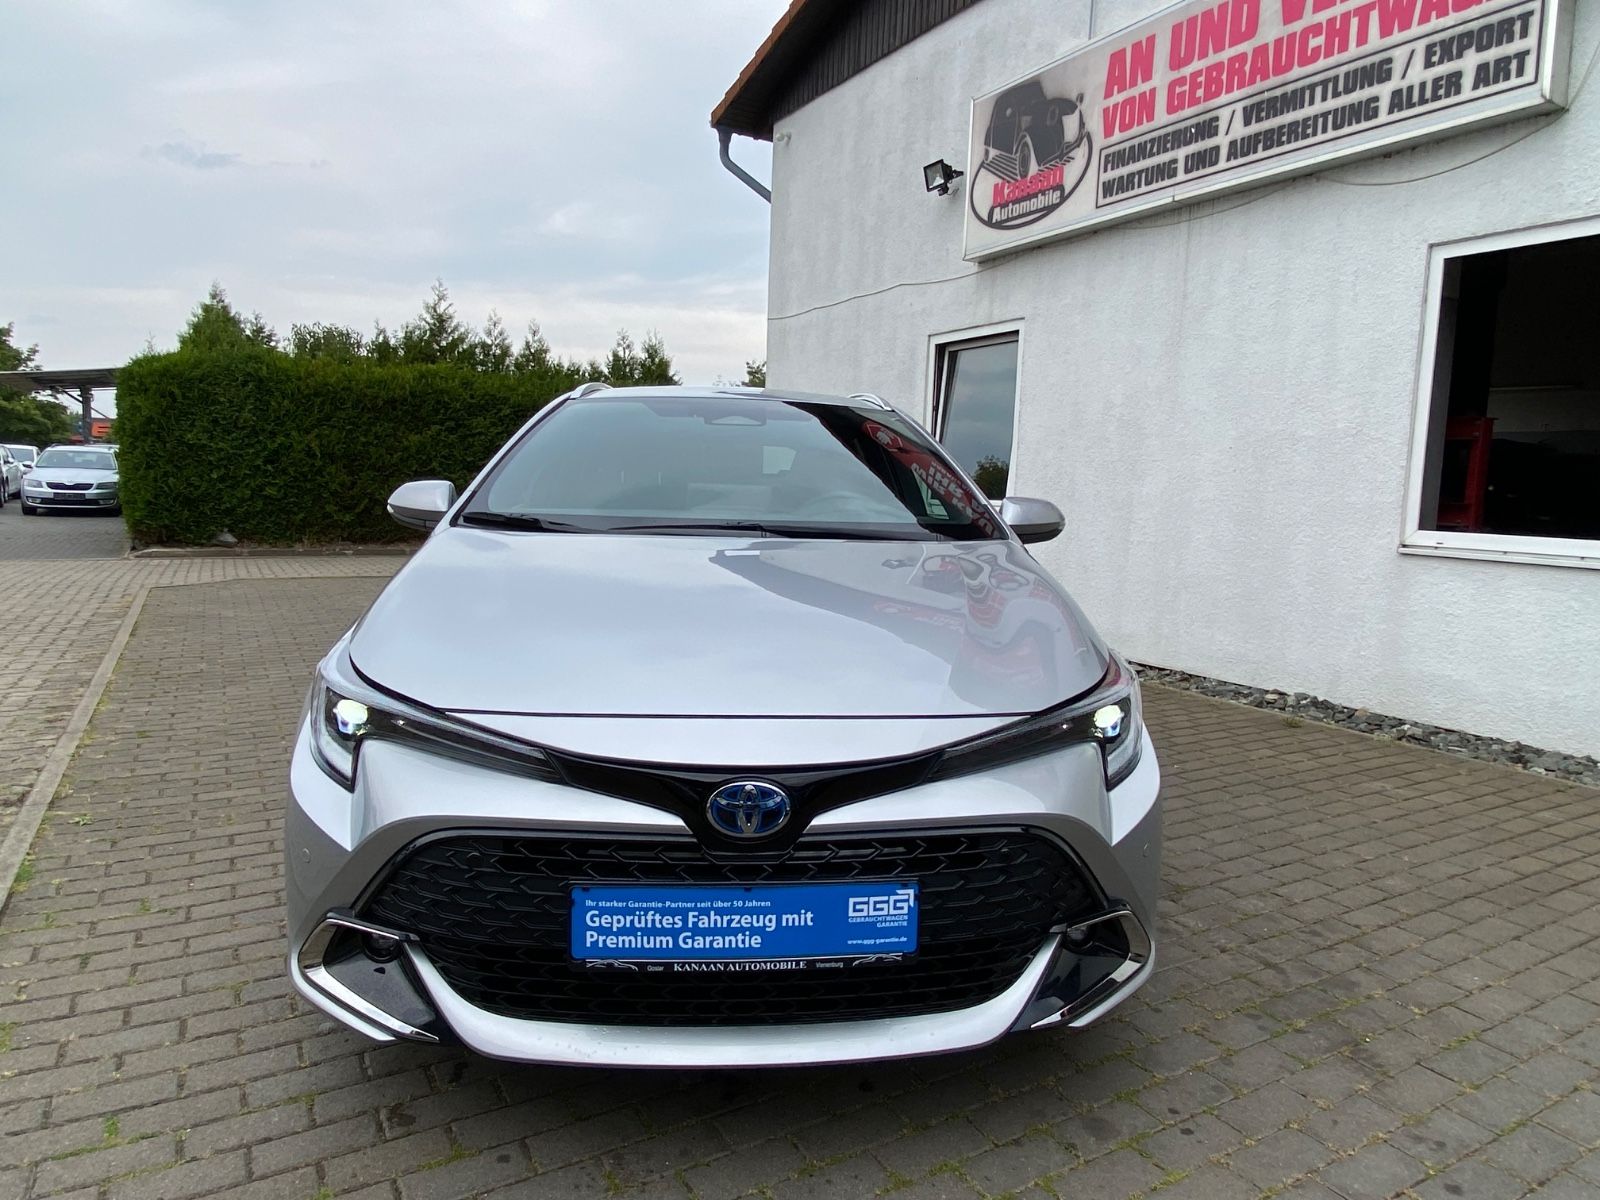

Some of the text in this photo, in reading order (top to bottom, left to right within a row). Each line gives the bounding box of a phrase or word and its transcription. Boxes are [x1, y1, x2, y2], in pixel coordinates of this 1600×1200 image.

[1104, 0, 1260, 99] AN UND
[1103, 0, 1492, 139] VON GEBRAUCHTWA
[1103, 116, 1220, 173] FINANZIERUNG
[1243, 58, 1393, 127] VERMITTLUNG
[1424, 10, 1534, 70] EXPORT
[1102, 50, 1530, 199] WARTUNG UND AUFBEREITUNG ALLER ART
[992, 165, 1064, 207] Kanaan
[992, 190, 1061, 223] Automobile
[585, 909, 814, 931] Geprüftes Fahrzeug mit
[598, 900, 626, 908] starker
[628, 900, 695, 908] Garantie-Partner
[697, 900, 711, 908] seit
[713, 900, 731, 908] über
[848, 894, 909, 917] GGG
[585, 931, 762, 948] Premium Garantie
[673, 963, 725, 971] KANAAN
[727, 961, 808, 971] AUTOMOBILE
